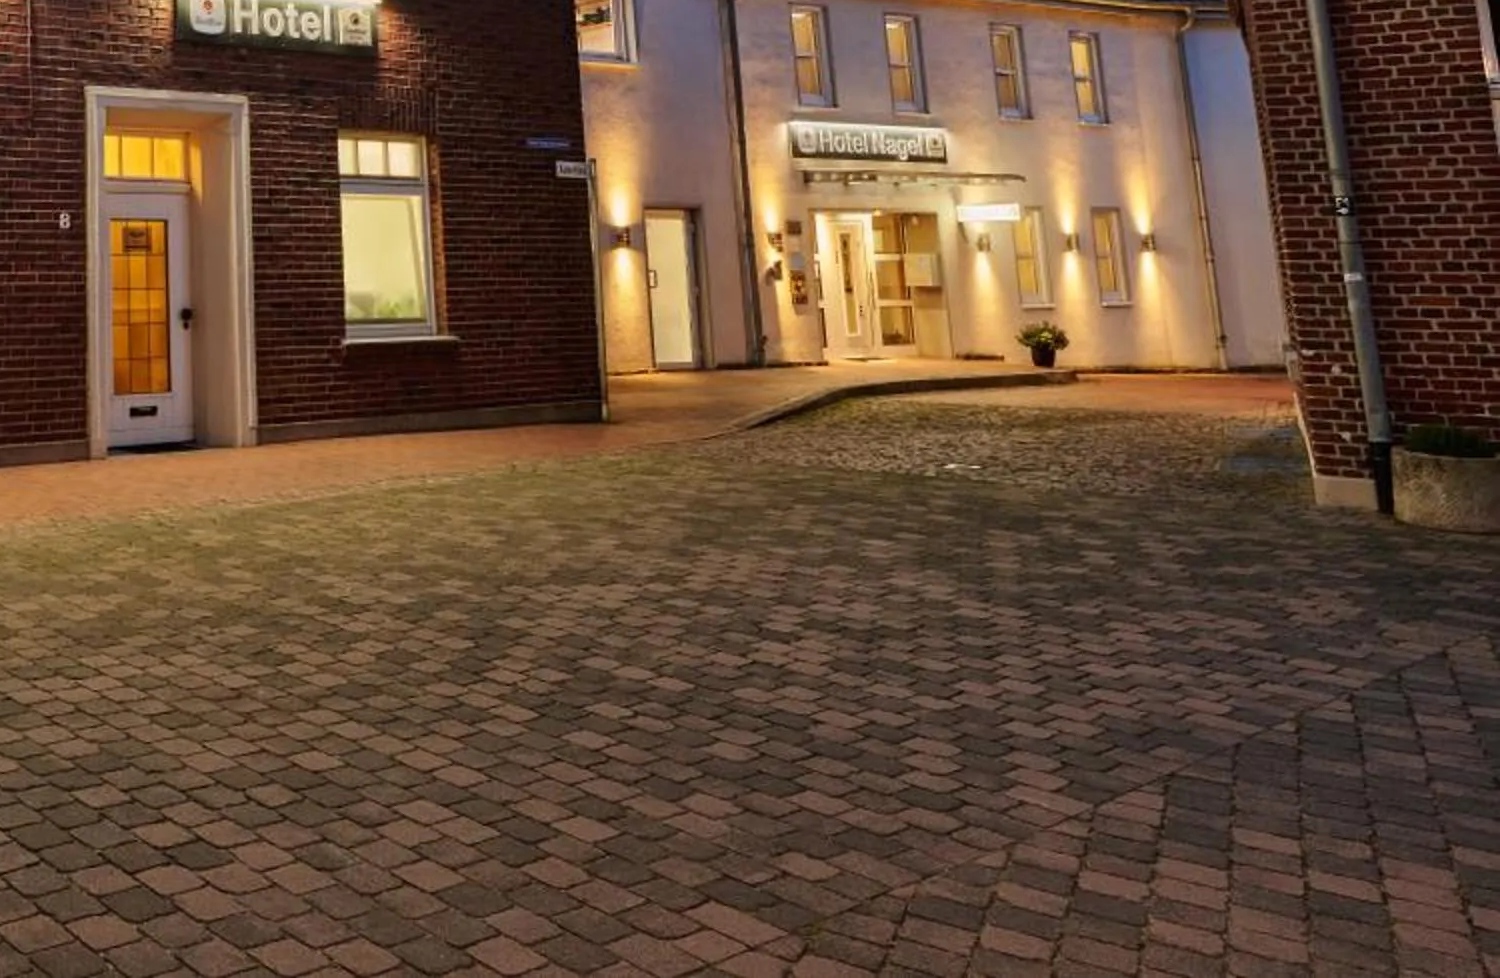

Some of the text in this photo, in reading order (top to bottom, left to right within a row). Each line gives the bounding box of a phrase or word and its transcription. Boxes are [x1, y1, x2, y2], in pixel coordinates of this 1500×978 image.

[818, 128, 924, 162] Hotel Nagel
[59, 213, 71, 229] 8
